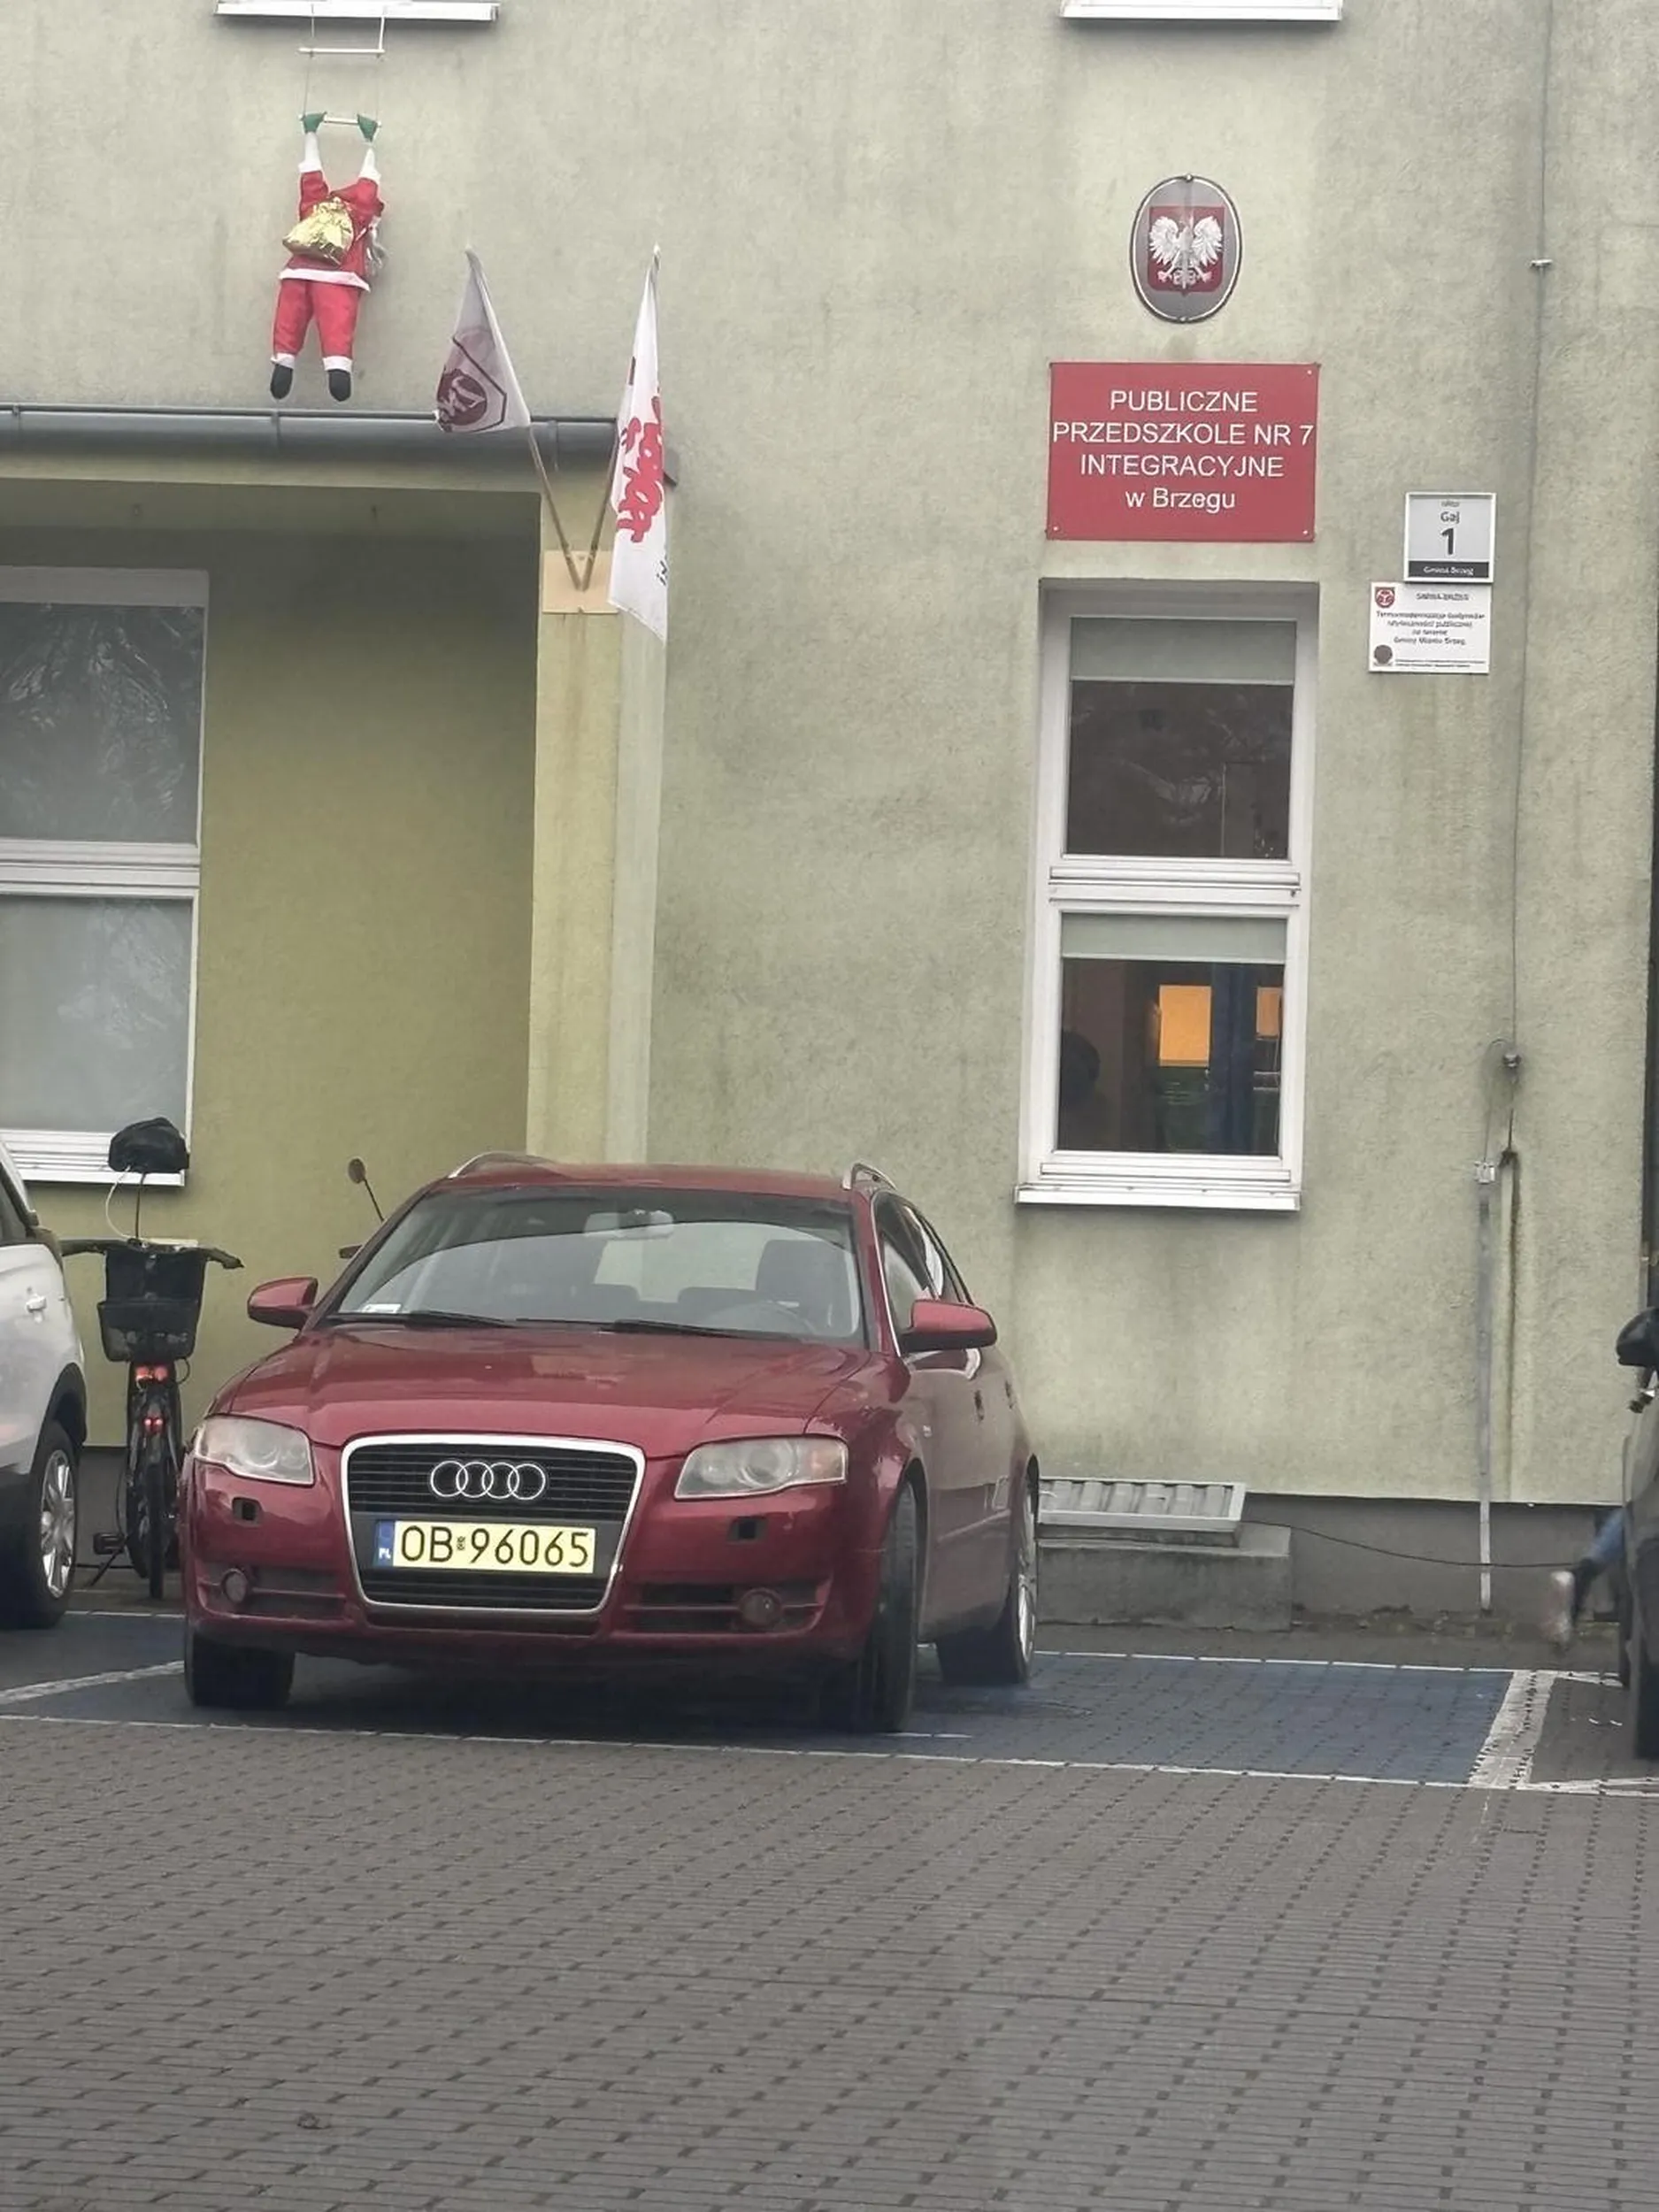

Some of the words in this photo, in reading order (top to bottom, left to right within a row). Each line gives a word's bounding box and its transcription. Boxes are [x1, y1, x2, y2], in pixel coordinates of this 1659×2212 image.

[1110, 390, 1258, 412] PUBLICZNE
[1053, 421, 1246, 445] PRZEDSZKOLE
[1254, 424, 1291, 446] NR
[1299, 425, 1315, 446] 7
[1080, 454, 1285, 478] INTEGRACYJNE
[1125, 491, 1145, 508] w
[1152, 488, 1236, 513] Brzegu
[1440, 511, 1460, 525] Gaj
[1440, 527, 1455, 556] 1
[400, 1525, 453, 1563] OB
[470, 1525, 589, 1569] 96065
